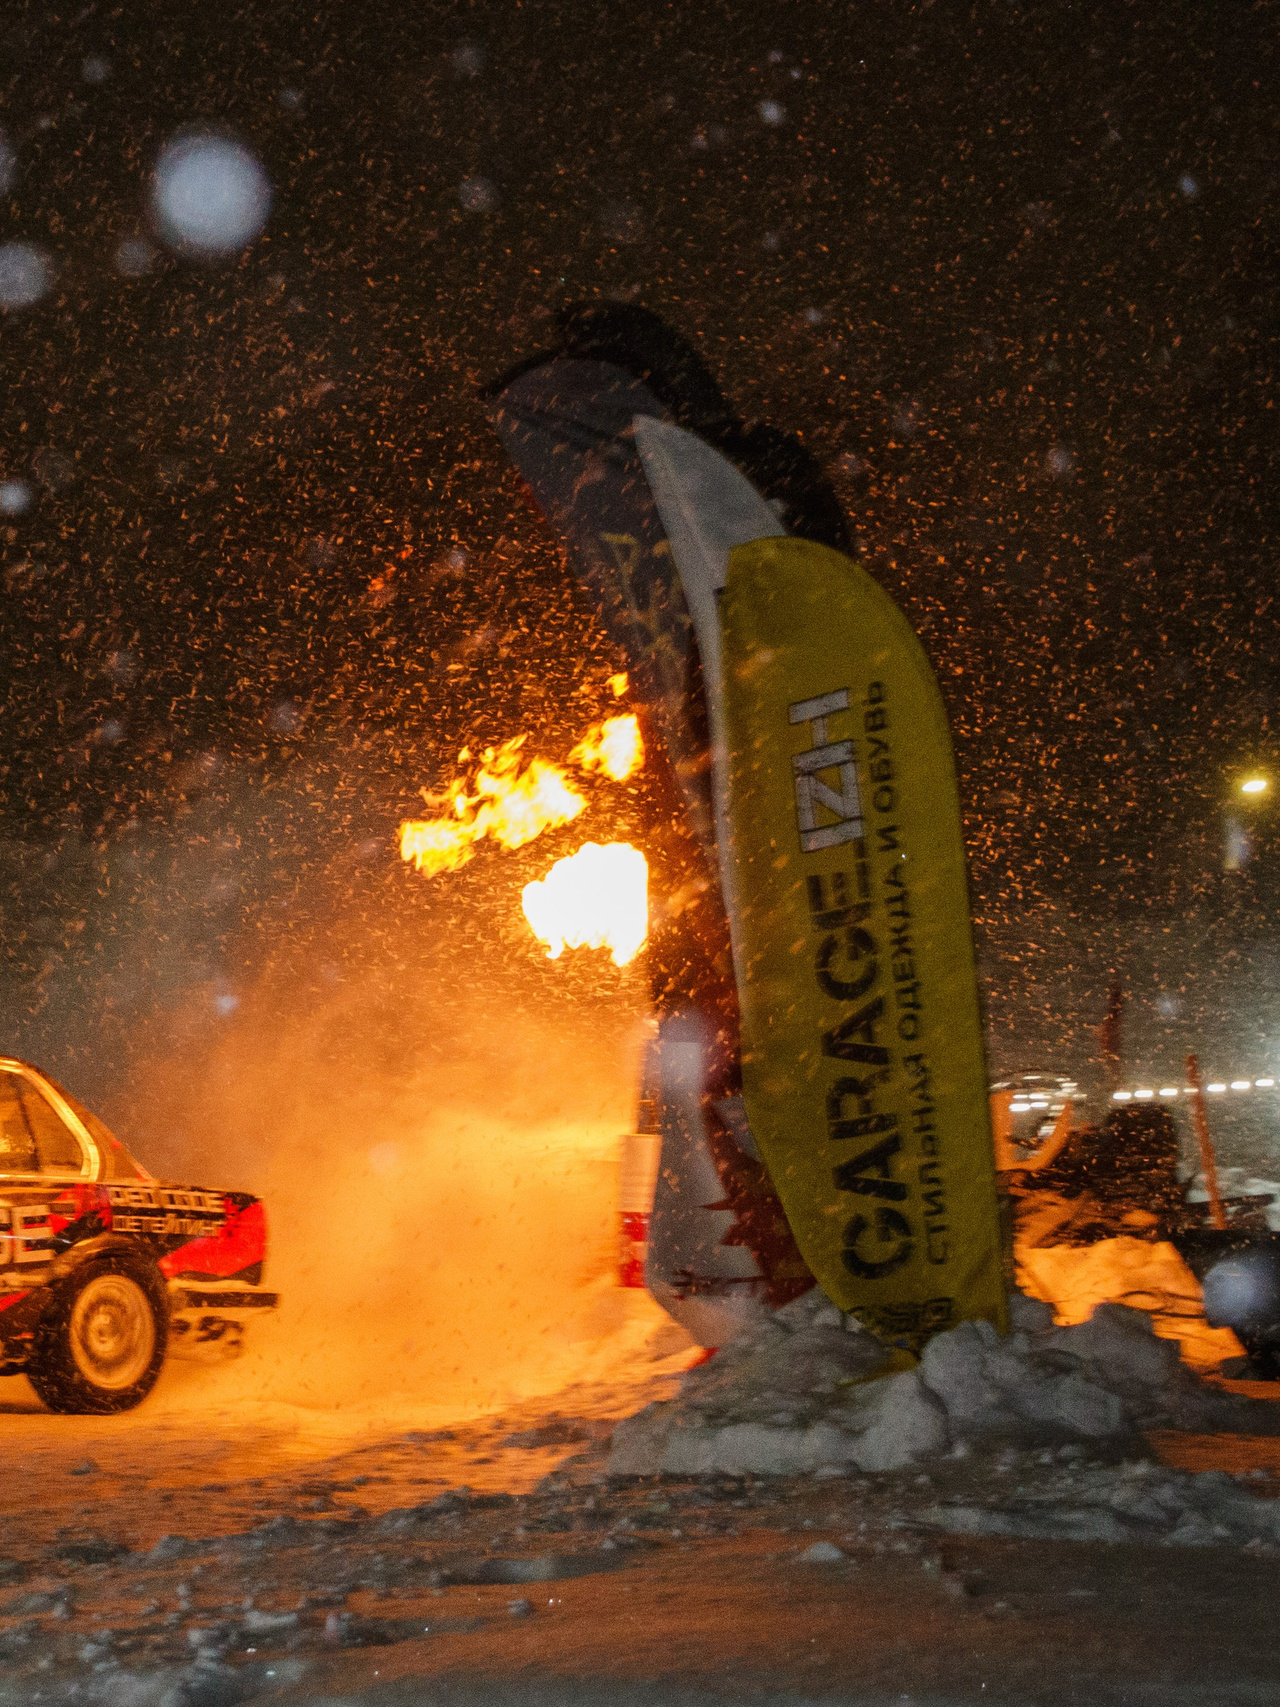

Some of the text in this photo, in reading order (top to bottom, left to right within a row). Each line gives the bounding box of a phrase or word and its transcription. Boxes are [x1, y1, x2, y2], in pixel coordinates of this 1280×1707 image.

[865, 680, 949, 1265] СТИЛЬНАЯ ОДЕЖДА И ОБУВЬ
